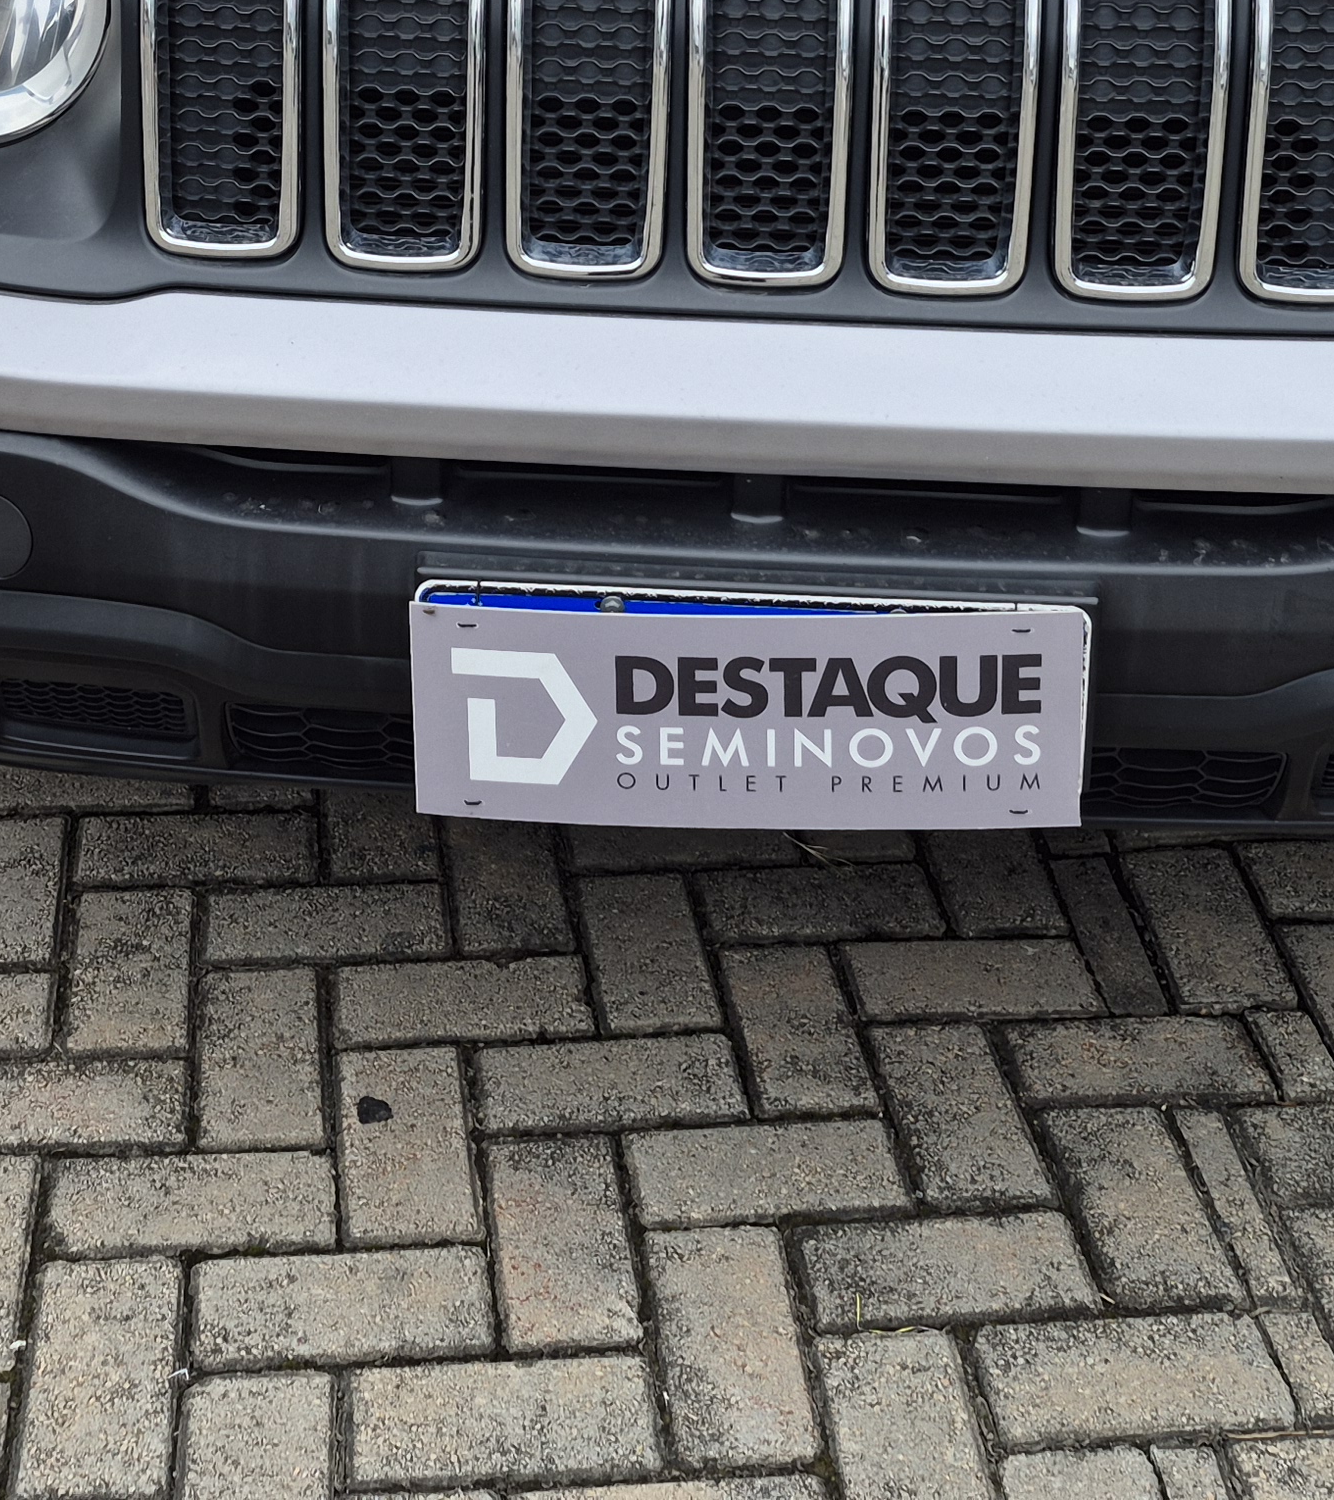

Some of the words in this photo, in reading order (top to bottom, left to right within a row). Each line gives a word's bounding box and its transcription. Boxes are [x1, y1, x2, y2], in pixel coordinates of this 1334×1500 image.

[615, 653, 1043, 724] DESTAQUE
[616, 724, 1042, 769] SEMINOVOS
[616, 772, 787, 793] OUTLET
[831, 772, 1042, 794] PREMIUM
